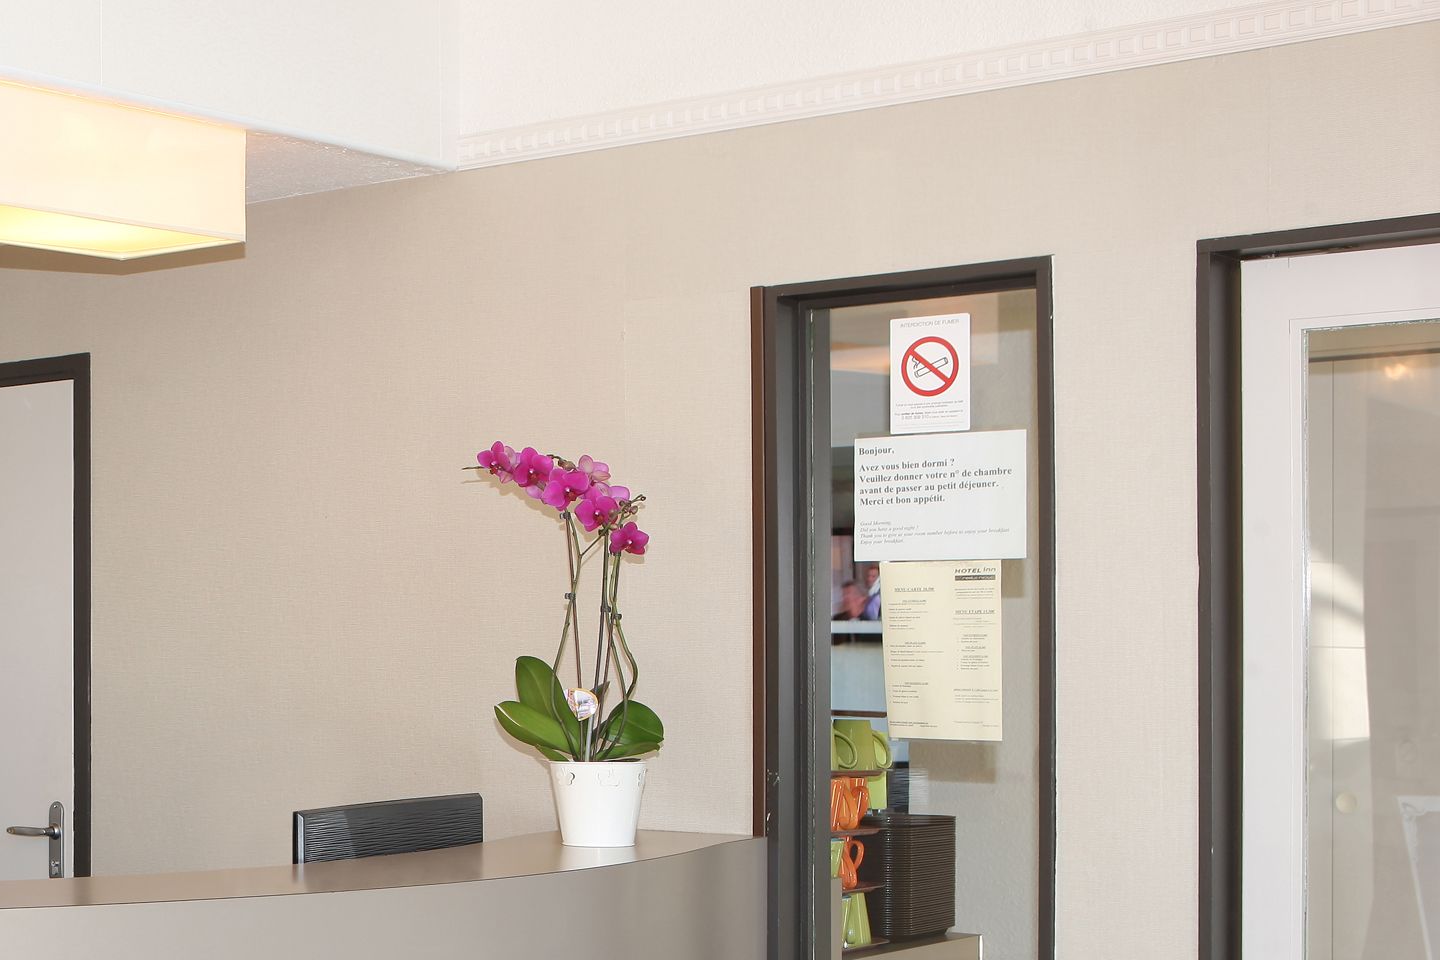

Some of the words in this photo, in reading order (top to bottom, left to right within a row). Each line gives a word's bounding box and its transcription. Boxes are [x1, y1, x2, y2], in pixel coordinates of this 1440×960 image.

[902, 462, 920, 470] bien
[922, 459, 948, 468] dormi
[950, 458, 955, 466] ?
[860, 474, 892, 483] Veuillez
[894, 472, 922, 482] donner
[925, 471, 948, 479] votre
[950, 470, 960, 478] n°
[962, 469, 972, 478] de
[974, 467, 1012, 477] chambre
[884, 486, 894, 494] de
[896, 484, 922, 494] passer
[937, 482, 956, 492] petit
[958, 480, 999, 490] déjeuner.
[860, 497, 884, 506] Merci
[896, 496, 911, 504] bon
[914, 494, 946, 504] appétit.
